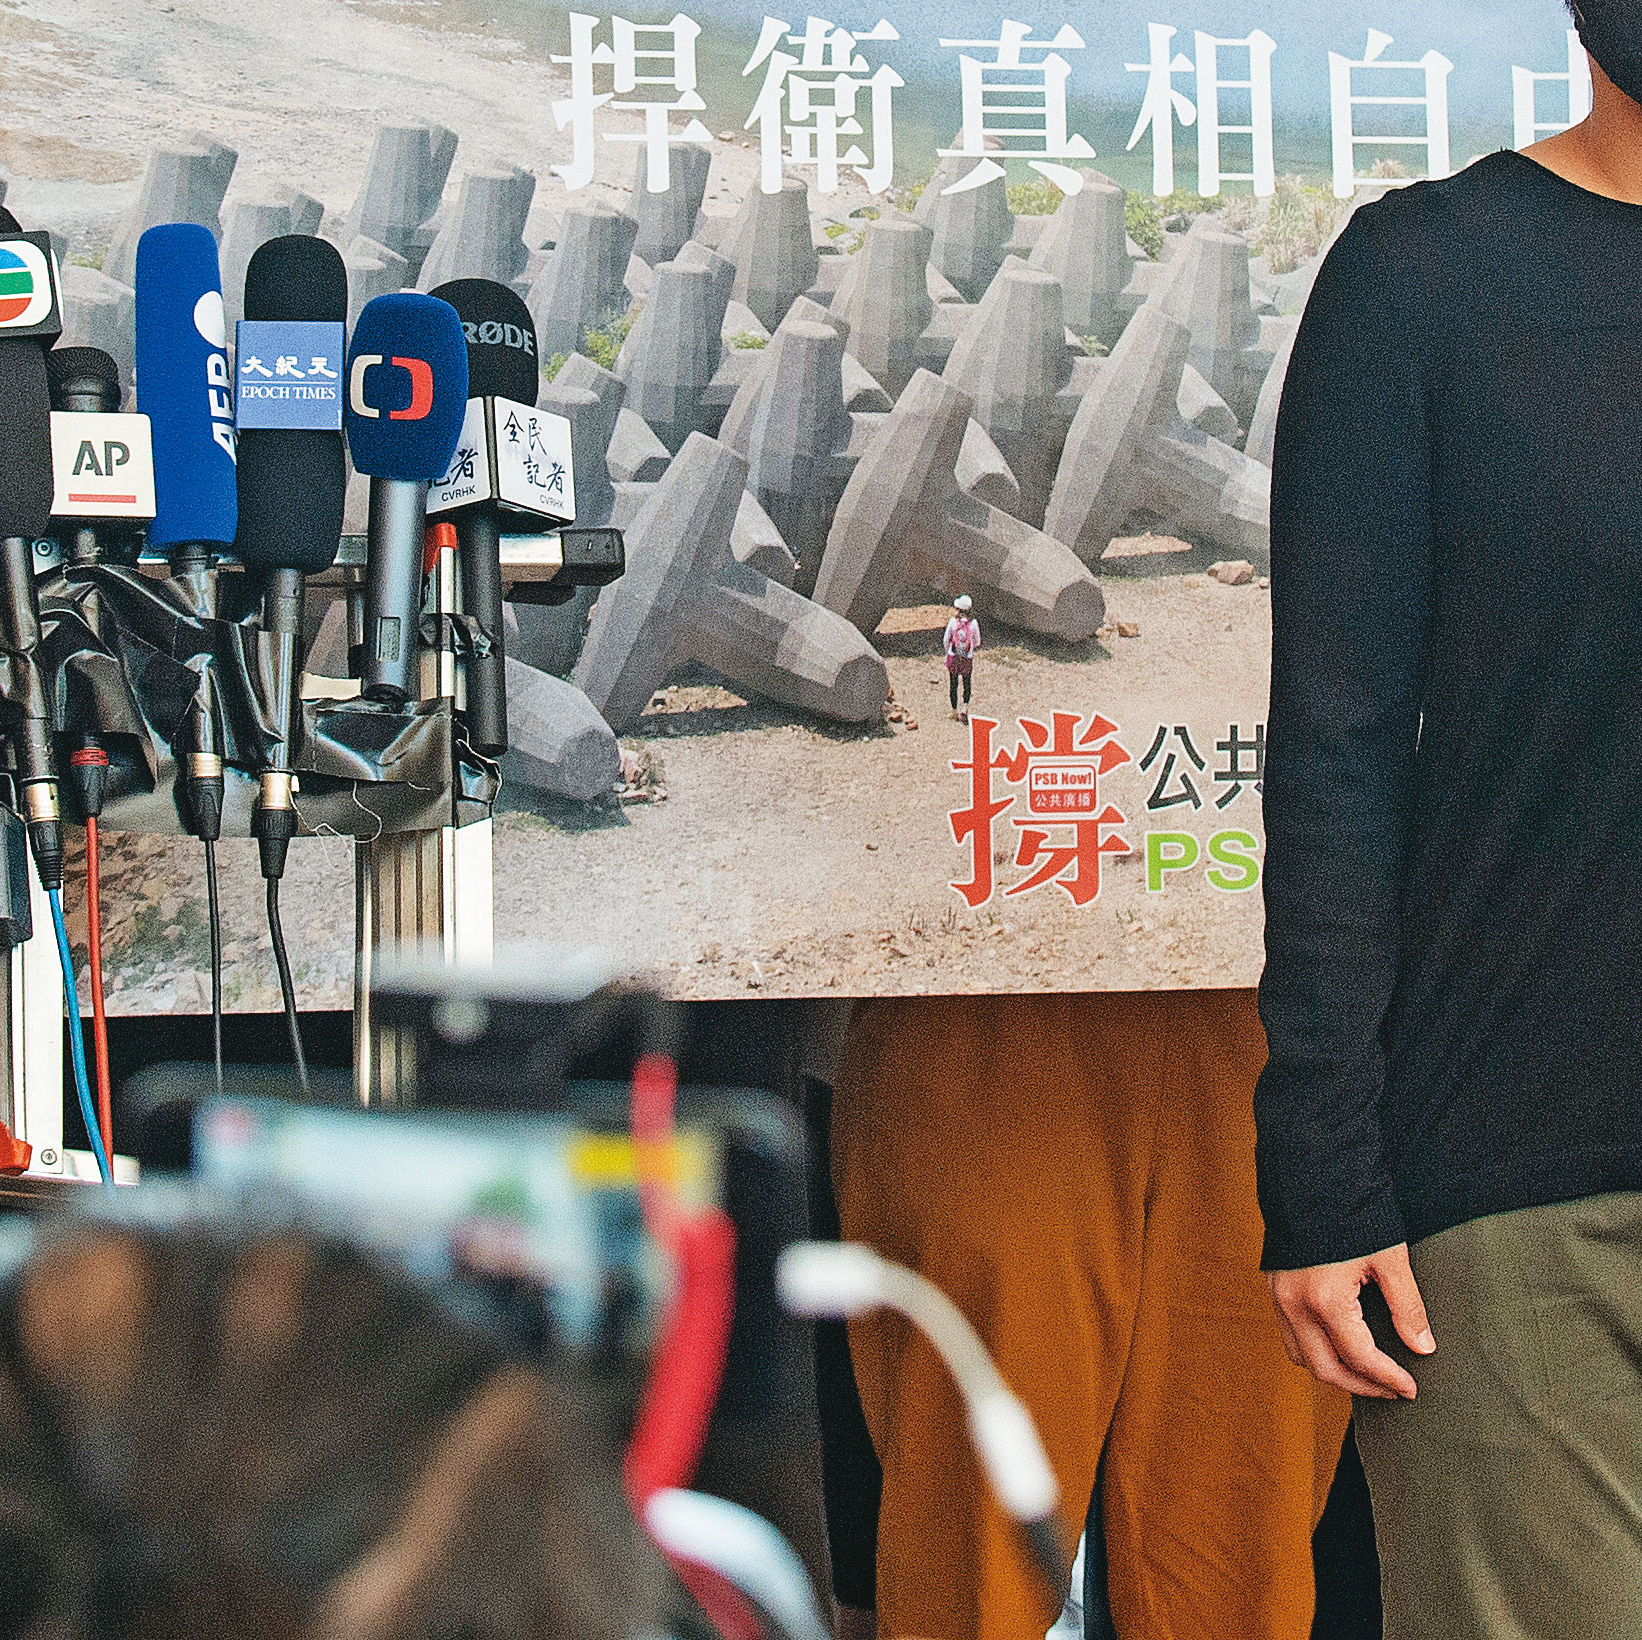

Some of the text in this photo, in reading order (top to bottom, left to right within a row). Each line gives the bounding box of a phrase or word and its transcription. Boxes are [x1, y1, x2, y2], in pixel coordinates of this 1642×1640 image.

[241, 356, 338, 378] 大紀元
[242, 386, 336, 399] EPOCH TIMES
[503, 411, 547, 455] 全民
[72, 440, 131, 476] AP
[523, 454, 566, 494] 記者
[442, 485, 476, 502] CVRHK
[539, 494, 565, 510] CVRHK
[1035, 773, 1091, 785] PSB Now!
[947, 711, 1133, 908] 撐
